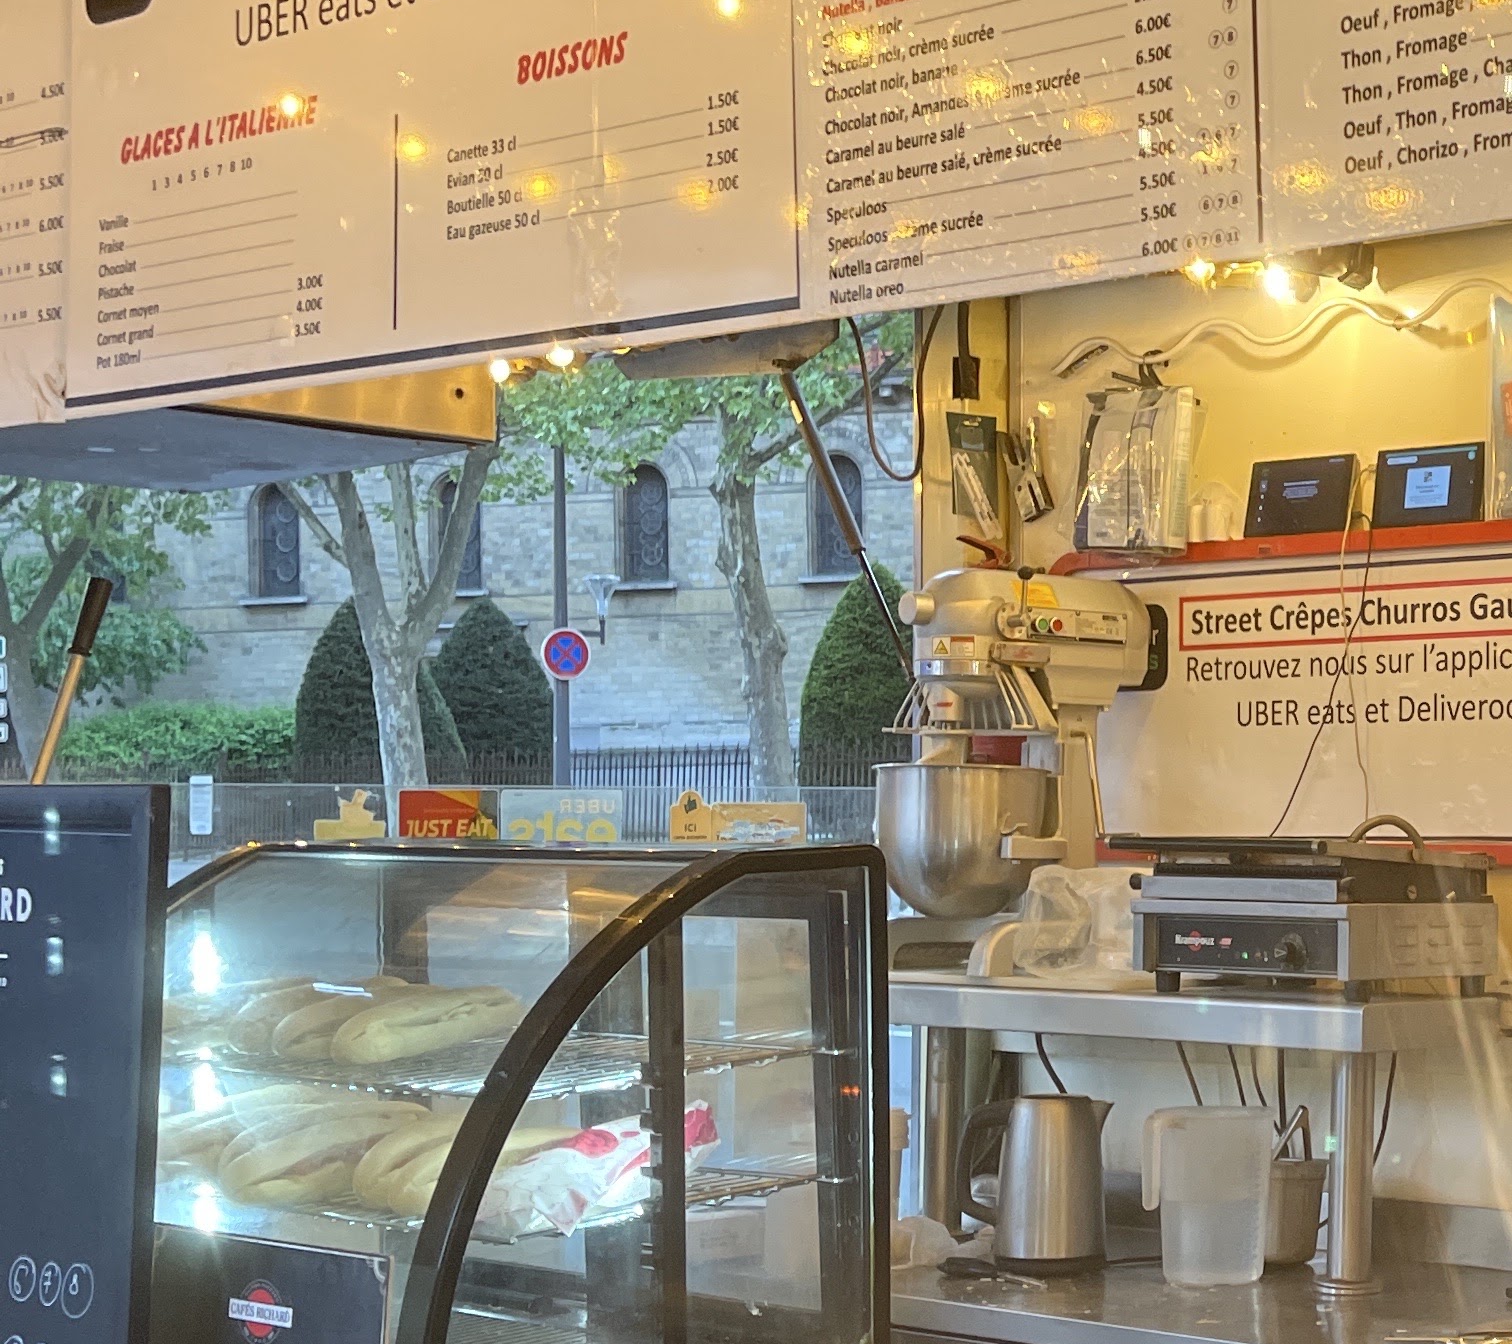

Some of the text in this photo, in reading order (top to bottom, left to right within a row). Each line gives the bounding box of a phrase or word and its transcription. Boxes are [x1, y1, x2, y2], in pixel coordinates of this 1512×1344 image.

[516, 32, 628, 86] BOISSONS
[447, 90, 739, 163] Canette 33 cl 1.50€
[120, 125, 185, 164] GLACES
[188, 122, 199, 150] A
[446, 210, 540, 240] Eau gazeuse 50 cl
[297, 275, 323, 290] 3.00€
[830, 238, 1177, 305] Nutella oreo 6.00€
[1191, 606, 1262, 636] Street
[1270, 602, 1352, 636] Crêpes
[1360, 597, 1461, 626] Churros
[1186, 655, 1301, 682] Retrouvez
[1309, 653, 1367, 677] nous
[1375, 651, 1414, 674] sur
[1236, 700, 1299, 727] UBER
[1307, 701, 1355, 725] eats
[1365, 699, 1388, 724] et
[405, 818, 493, 839] JUST EAT
[256, 1305, 292, 1326] RICHARD
